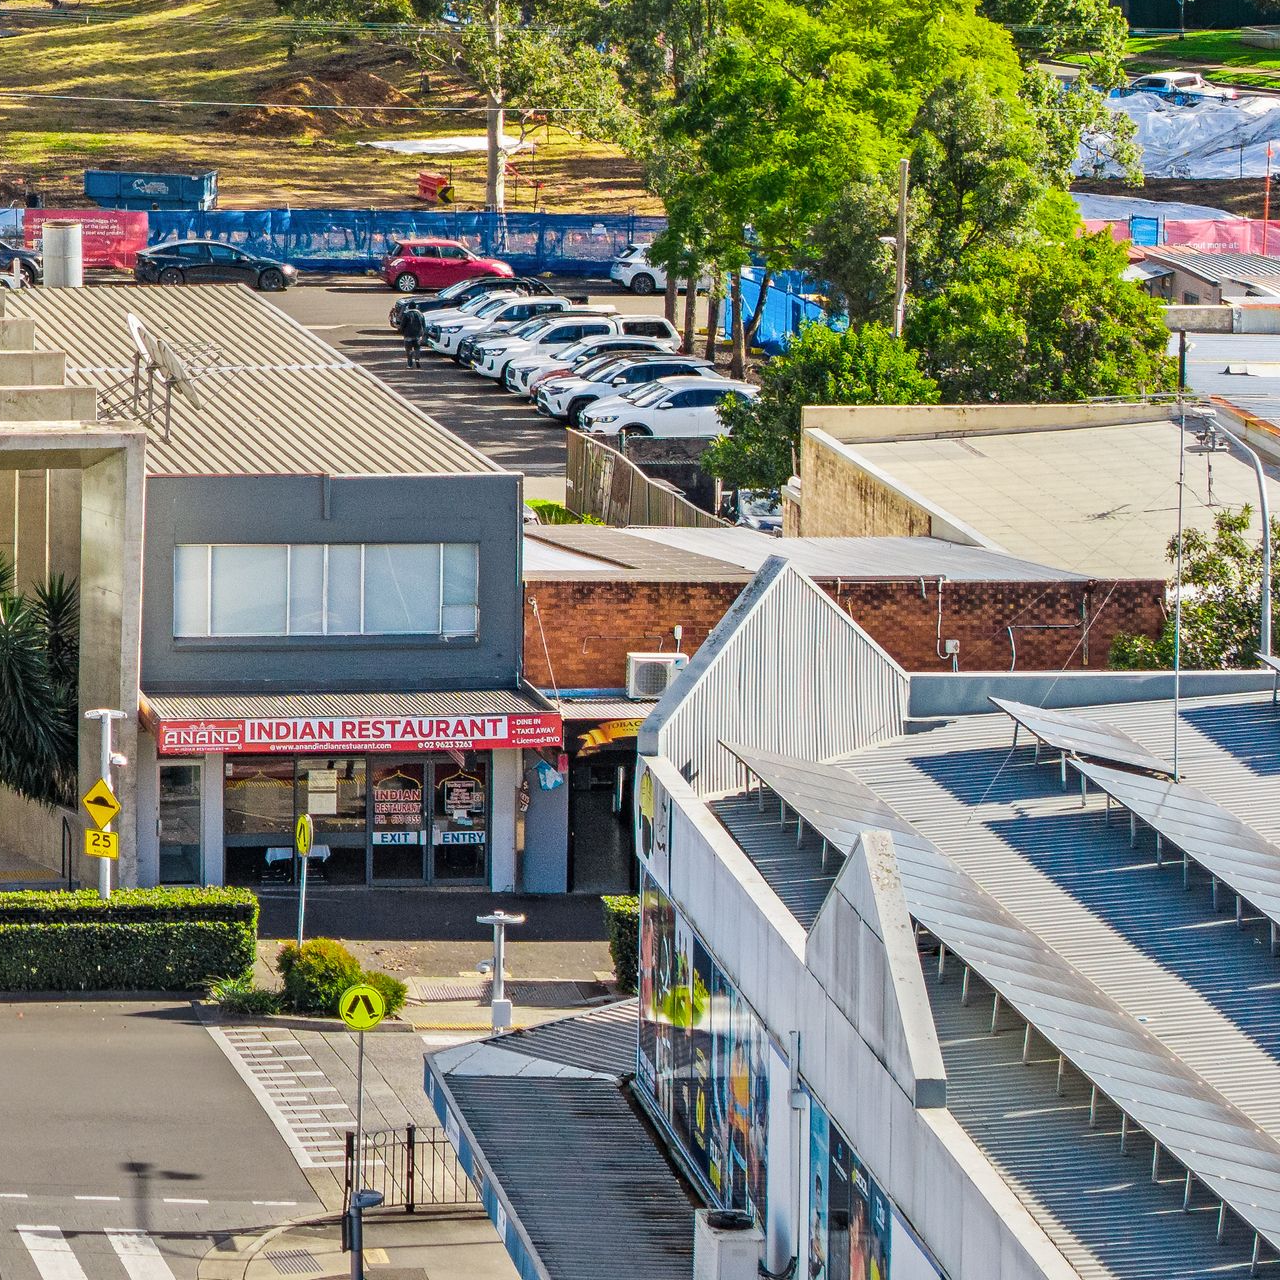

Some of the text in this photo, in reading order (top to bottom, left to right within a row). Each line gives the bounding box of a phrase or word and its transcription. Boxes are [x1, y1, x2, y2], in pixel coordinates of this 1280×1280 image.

[250, 718, 503, 741] INDIAN RESTAURANT
[165, 731, 240, 744] ANAND
[375, 789, 421, 800] INDIAN
[375, 802, 421, 813] RESTAURANT
[92, 833, 111, 848] 25
[381, 833, 410, 843] EXIT
[443, 832, 484, 843] ENTRY
